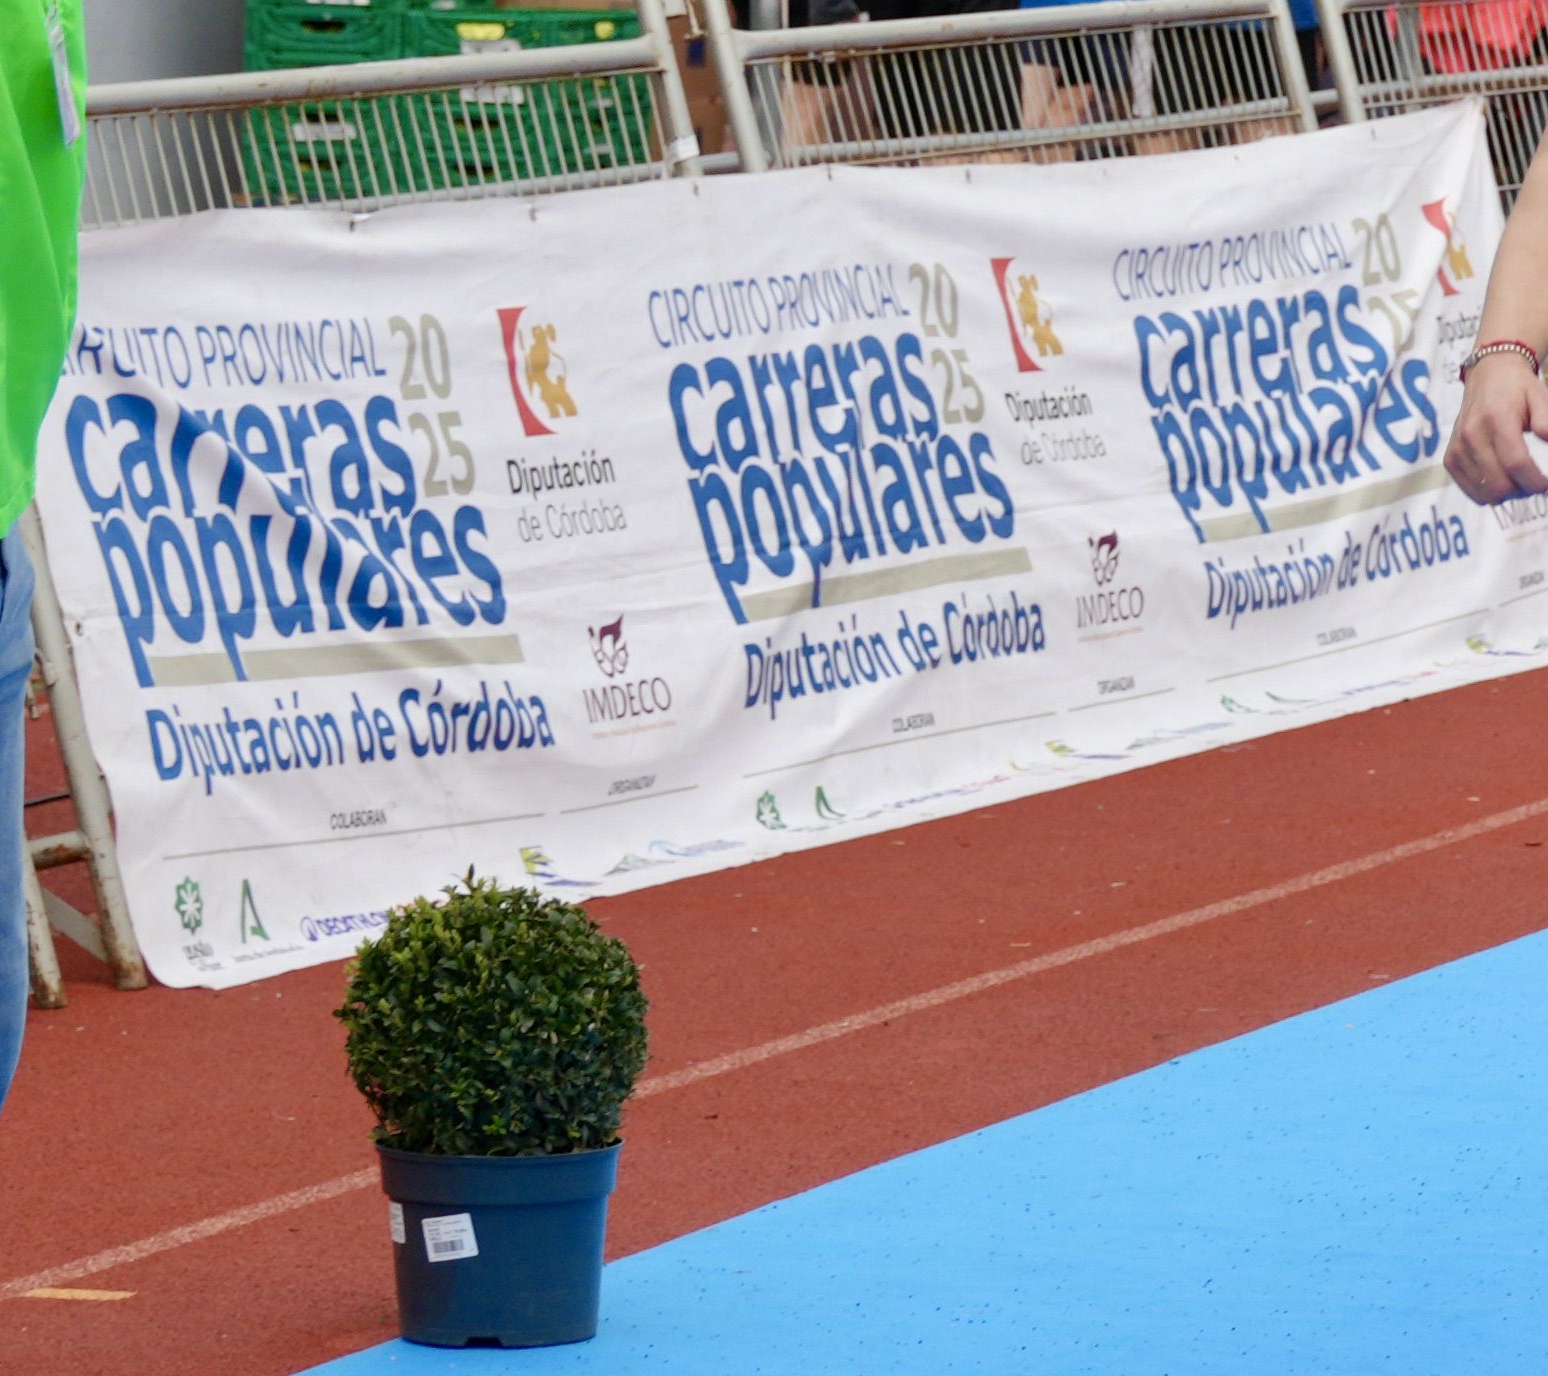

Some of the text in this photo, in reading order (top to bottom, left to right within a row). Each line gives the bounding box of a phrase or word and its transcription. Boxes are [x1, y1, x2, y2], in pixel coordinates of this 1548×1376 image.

[1113, 222, 1353, 303] CIRCUITO PROVINCIAL
[1352, 212, 1403, 287] 20
[649, 263, 910, 350] CIRCUITO PROVINCIAL
[908, 262, 960, 339] 20
[195, 317, 388, 388] PROVINCIAL
[388, 313, 452, 401] 20
[932, 346, 987, 425] 25
[1134, 284, 1390, 407] carreras
[668, 332, 938, 474] carreras
[1004, 385, 1094, 428] Diputación
[65, 392, 417, 522] carreras
[407, 410, 475, 498] 25
[507, 449, 617, 496] Diputación
[1020, 427, 1107, 466] de Córdoba
[1151, 358, 1441, 544] populares
[517, 498, 628, 544] de Córdoba
[686, 430, 1016, 625] populares
[91, 504, 507, 688] populares
[1076, 584, 1145, 627] IMDECO
[1204, 504, 1471, 630] Diputación de Córdoba
[582, 676, 672, 724] IMDECO
[744, 596, 1048, 721] Diputación de Córdoba
[145, 678, 556, 796] Diputación de Córdoba
[329, 808, 388, 830] COLABORAN
